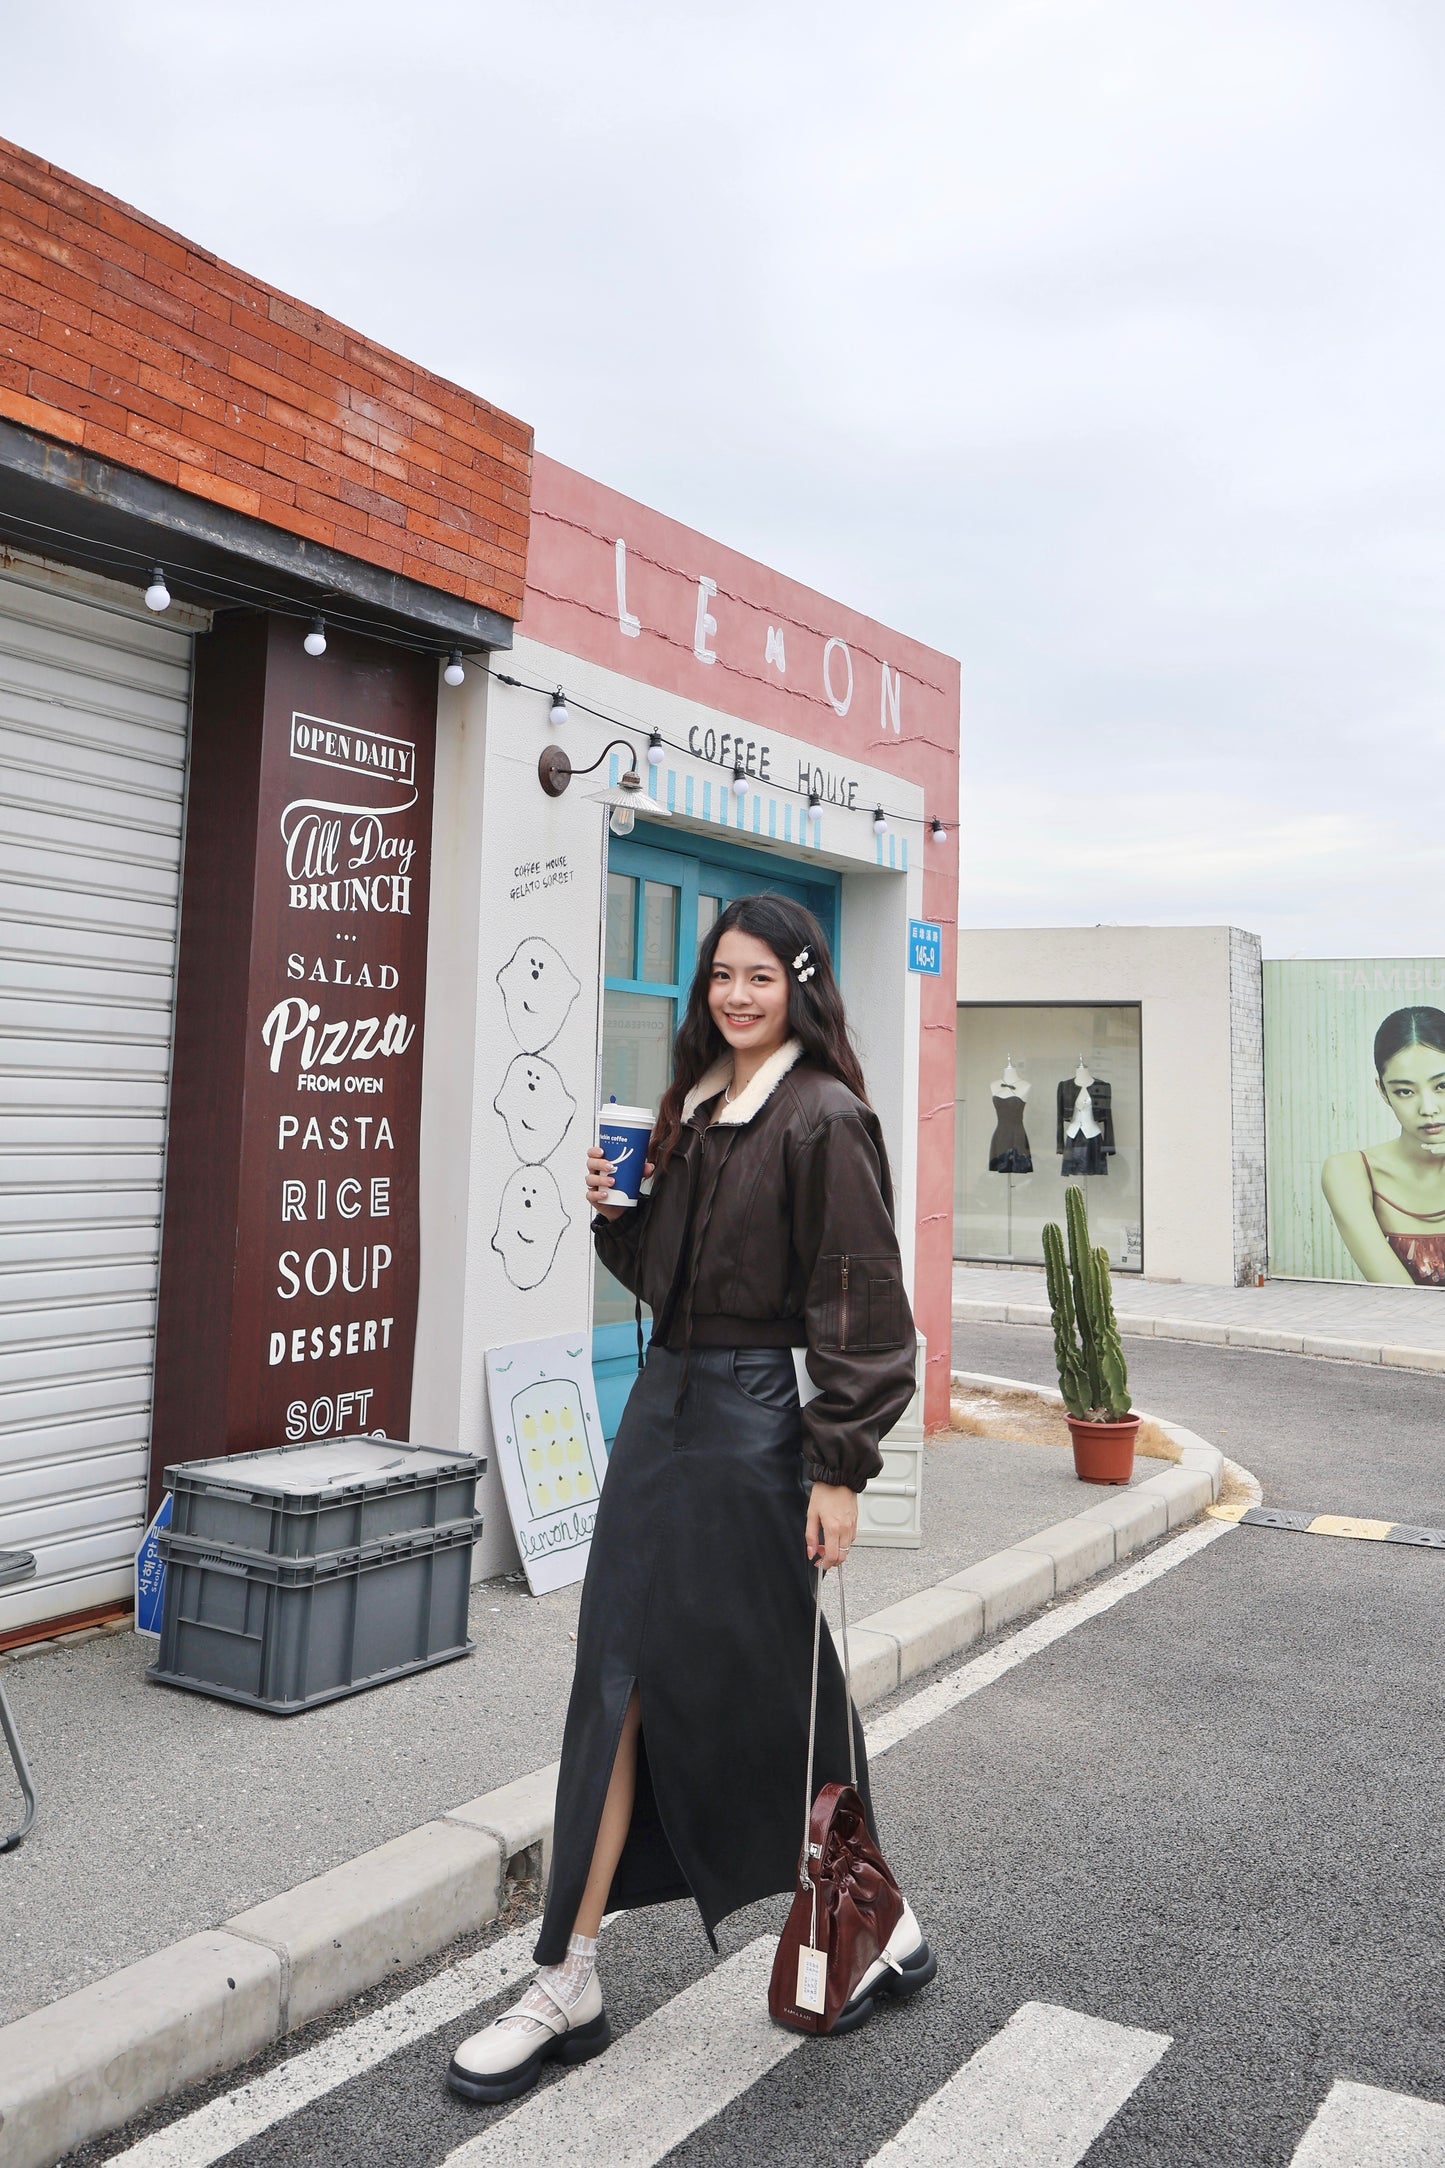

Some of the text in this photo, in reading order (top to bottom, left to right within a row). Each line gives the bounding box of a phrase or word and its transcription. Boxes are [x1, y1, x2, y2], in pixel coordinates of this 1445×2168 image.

[615, 538, 901, 734] LEMON
[296, 723, 410, 773] OPEN DAILY
[688, 725, 859, 811] COFFEE HOUSE
[281, 799, 417, 880] All Day
[510, 870, 575, 901] GELATO SORBET
[514, 855, 568, 878] COFFEE HOUSE
[288, 874, 412, 915] BRUNCH
[287, 953, 400, 990] SALAD
[262, 997, 416, 1073] Pizza
[297, 1074, 384, 1094] FROM OVEN
[278, 1115, 395, 1150] PASTA
[611, 1135, 628, 1143] coffee
[281, 1177, 391, 1222] RICE
[276, 1244, 393, 1299] SOUP
[268, 1317, 394, 1366] DESSERT
[285, 1388, 374, 1440] SOFT
[519, 1519, 574, 1560] lemon
